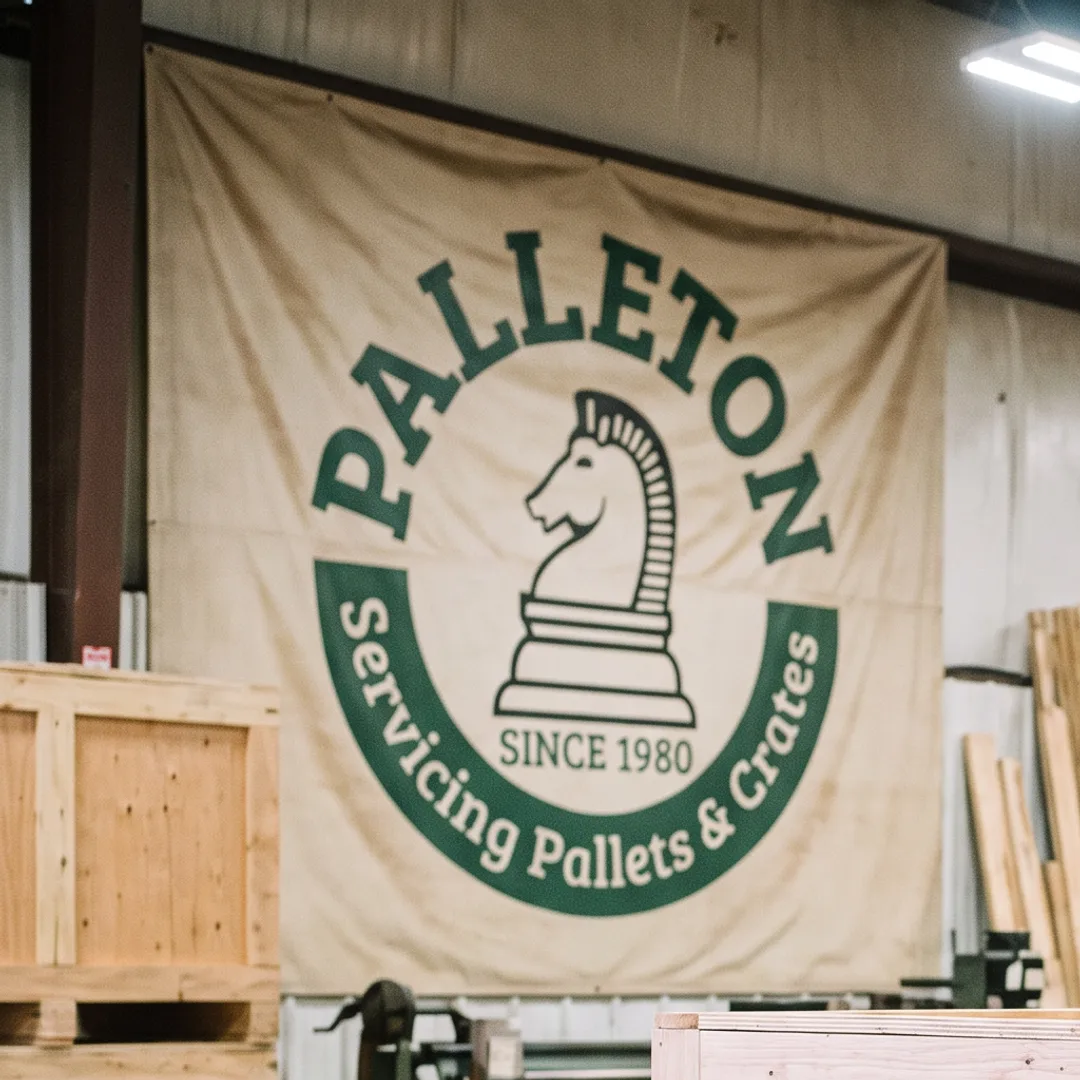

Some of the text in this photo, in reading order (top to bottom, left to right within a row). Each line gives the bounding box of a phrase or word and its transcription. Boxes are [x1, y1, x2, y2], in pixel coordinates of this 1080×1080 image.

[311, 231, 834, 565] PALLETON
[341, 597, 819, 889] Servicing Pallets & Crates
[499, 728, 694, 775] SINCE 1980
